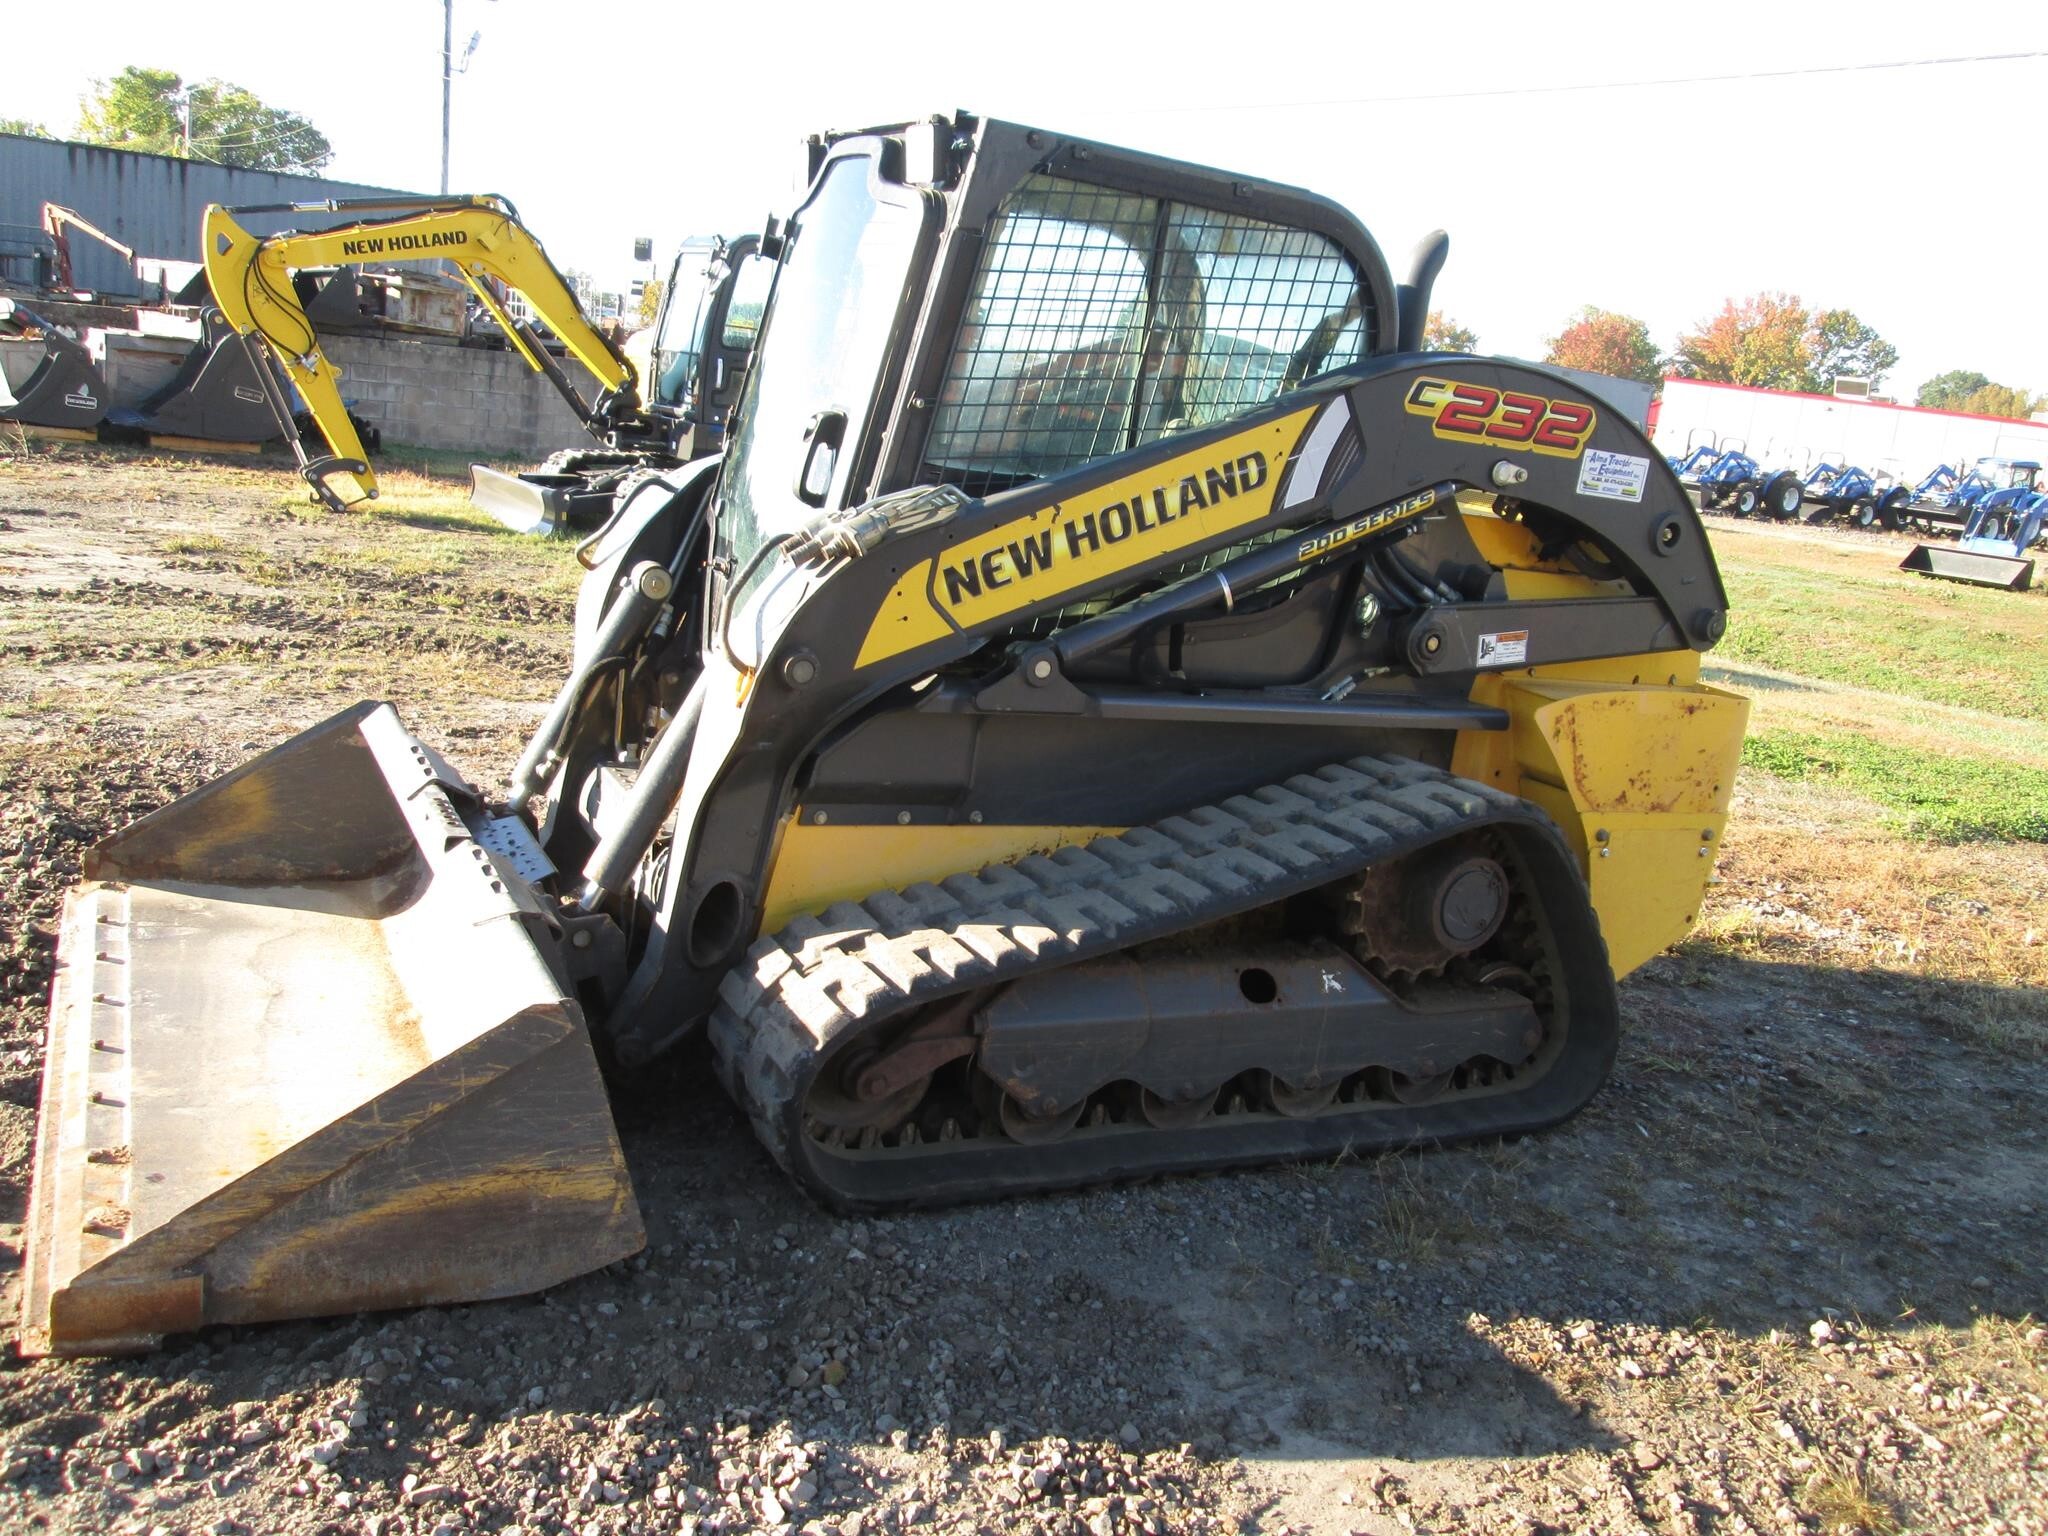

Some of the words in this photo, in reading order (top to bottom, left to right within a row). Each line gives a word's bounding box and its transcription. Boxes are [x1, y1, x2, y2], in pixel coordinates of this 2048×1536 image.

[343, 238, 384, 256] NEW
[388, 230, 468, 251] HOLLAND
[1407, 379, 1594, 452] C232
[1598, 464, 1633, 477] Equipment
[1609, 454, 1632, 467] Tractor
[942, 527, 1053, 606] NEW
[1063, 450, 1270, 560] HOLLAND
[1299, 526, 1348, 554] 200
[1352, 489, 1434, 533] SERIES
